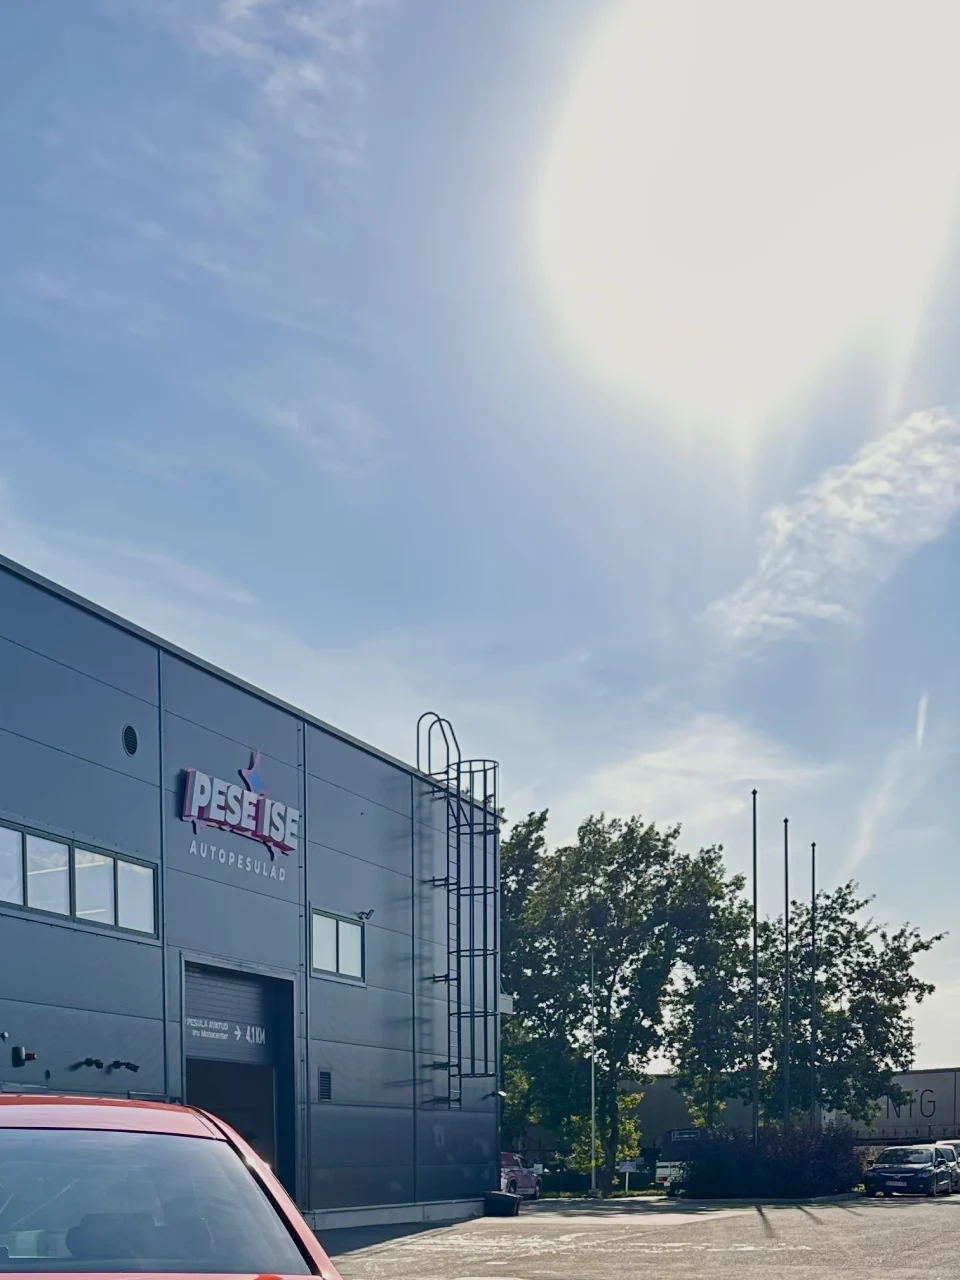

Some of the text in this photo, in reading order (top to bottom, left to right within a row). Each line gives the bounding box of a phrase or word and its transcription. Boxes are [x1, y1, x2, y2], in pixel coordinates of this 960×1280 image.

[189, 769, 300, 851] PESE ISE
[190, 839, 286, 881] AUTOPESULAD
